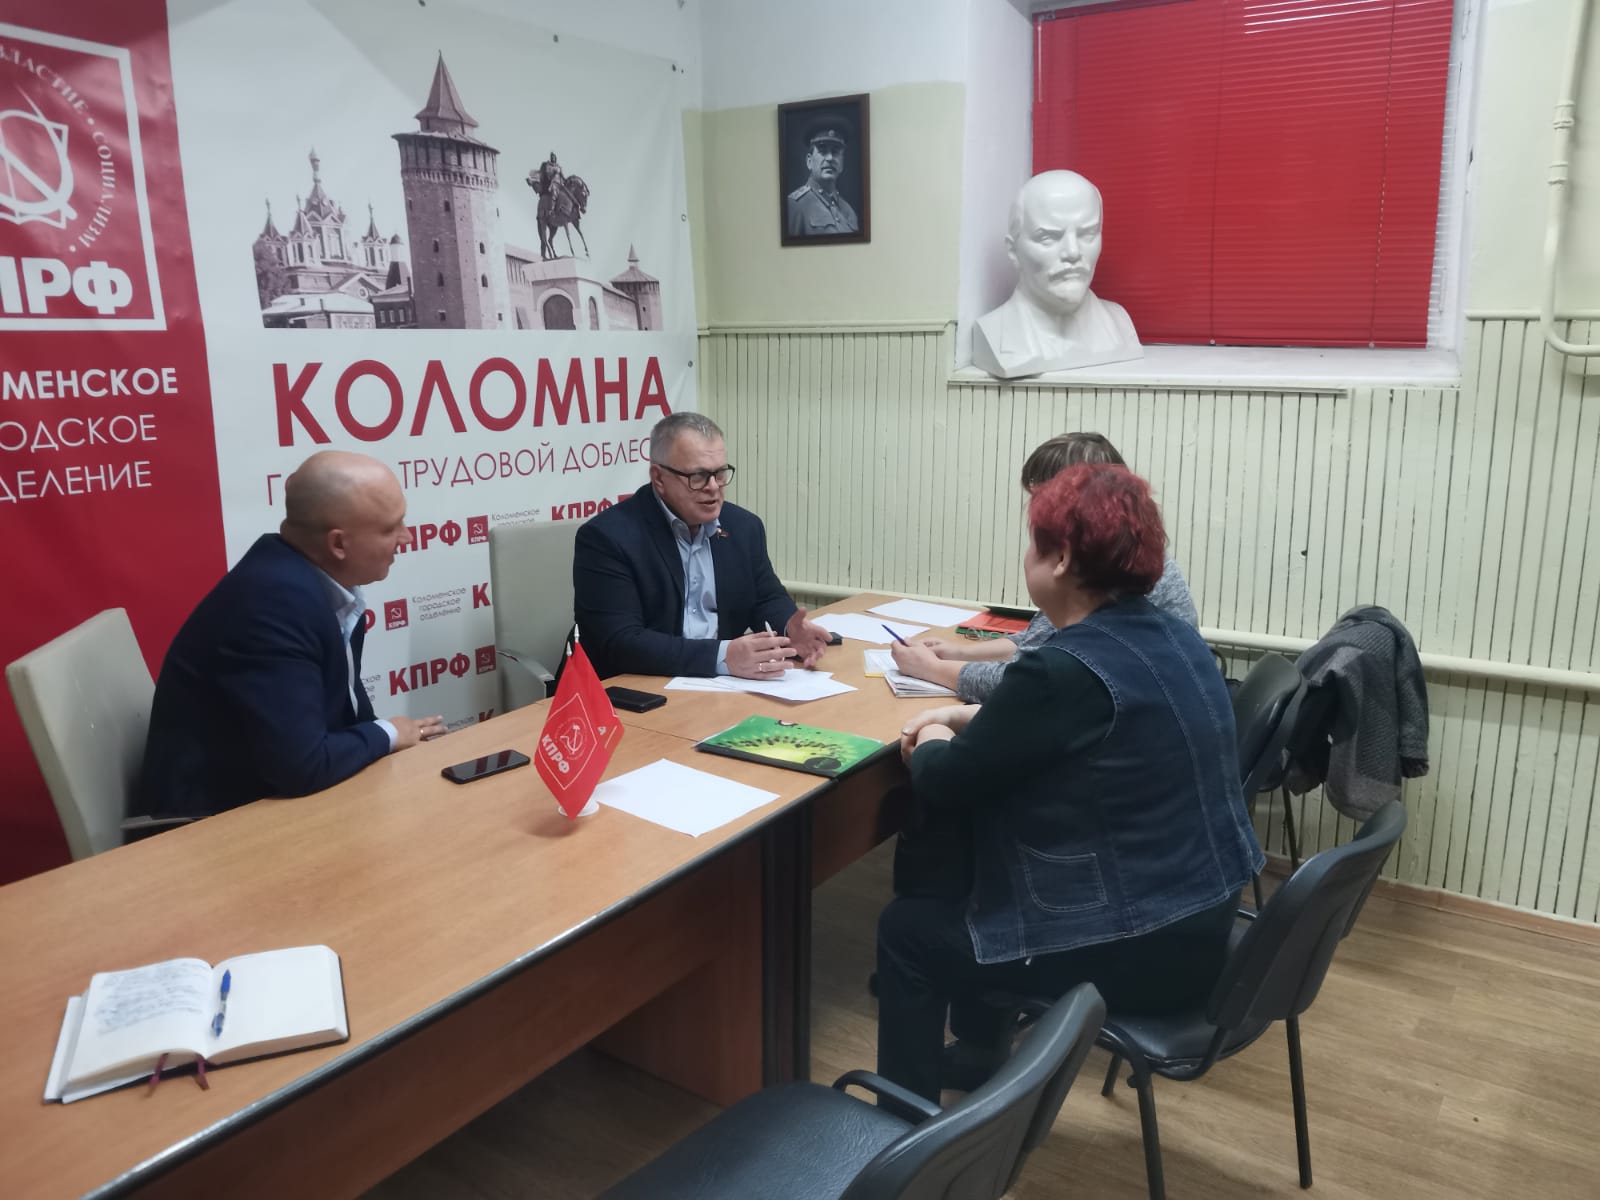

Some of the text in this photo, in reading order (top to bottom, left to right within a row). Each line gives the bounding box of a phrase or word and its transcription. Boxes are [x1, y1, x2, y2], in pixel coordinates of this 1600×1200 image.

[2, 367, 178, 400] МЕНСКОЕ
[272, 356, 672, 448] КОЛОМНА
[398, 441, 554, 490] ТРУДОВОЙ
[396, 519, 462, 555] ПРФ
[389, 652, 471, 697] КПРФ
[541, 733, 570, 774] КПРФ
